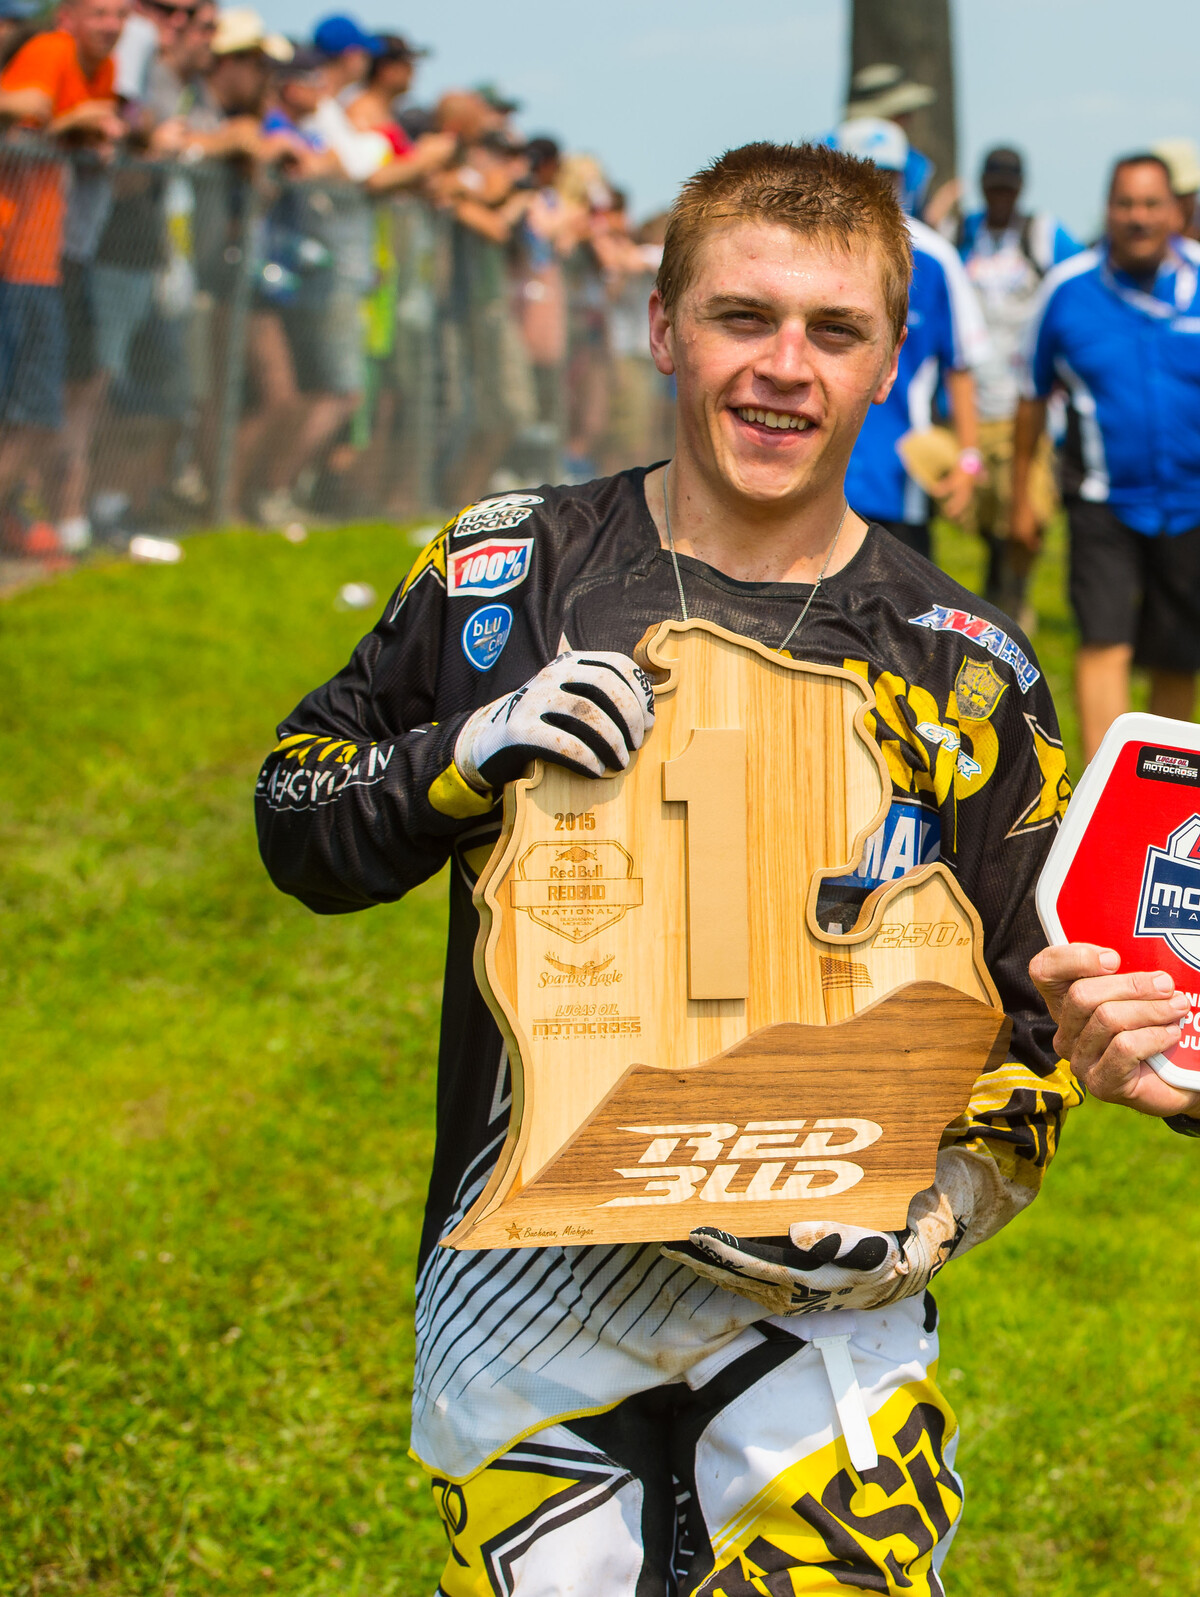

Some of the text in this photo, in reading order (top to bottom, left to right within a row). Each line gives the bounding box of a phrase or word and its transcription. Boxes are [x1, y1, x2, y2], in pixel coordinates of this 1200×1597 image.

[457, 516, 520, 533] ROCKY
[461, 508, 526, 524] TUCKER
[460, 548, 524, 586] 100%
[1143, 762, 1198, 778] MOTOCROSS
[554, 812, 596, 831] 2015
[550, 864, 603, 878] Red Bull
[662, 728, 749, 1000] 1
[548, 884, 606, 901] REDBUD
[541, 908, 613, 916] NATIONAL
[872, 922, 960, 948] 250
[538, 969, 623, 988] Soaring Eagle
[555, 1003, 597, 1017] LUCAS
[532, 1022, 642, 1036] MOTOCROSS
[616, 1118, 883, 1163] RED
[562, 1225, 595, 1239] Michigan
